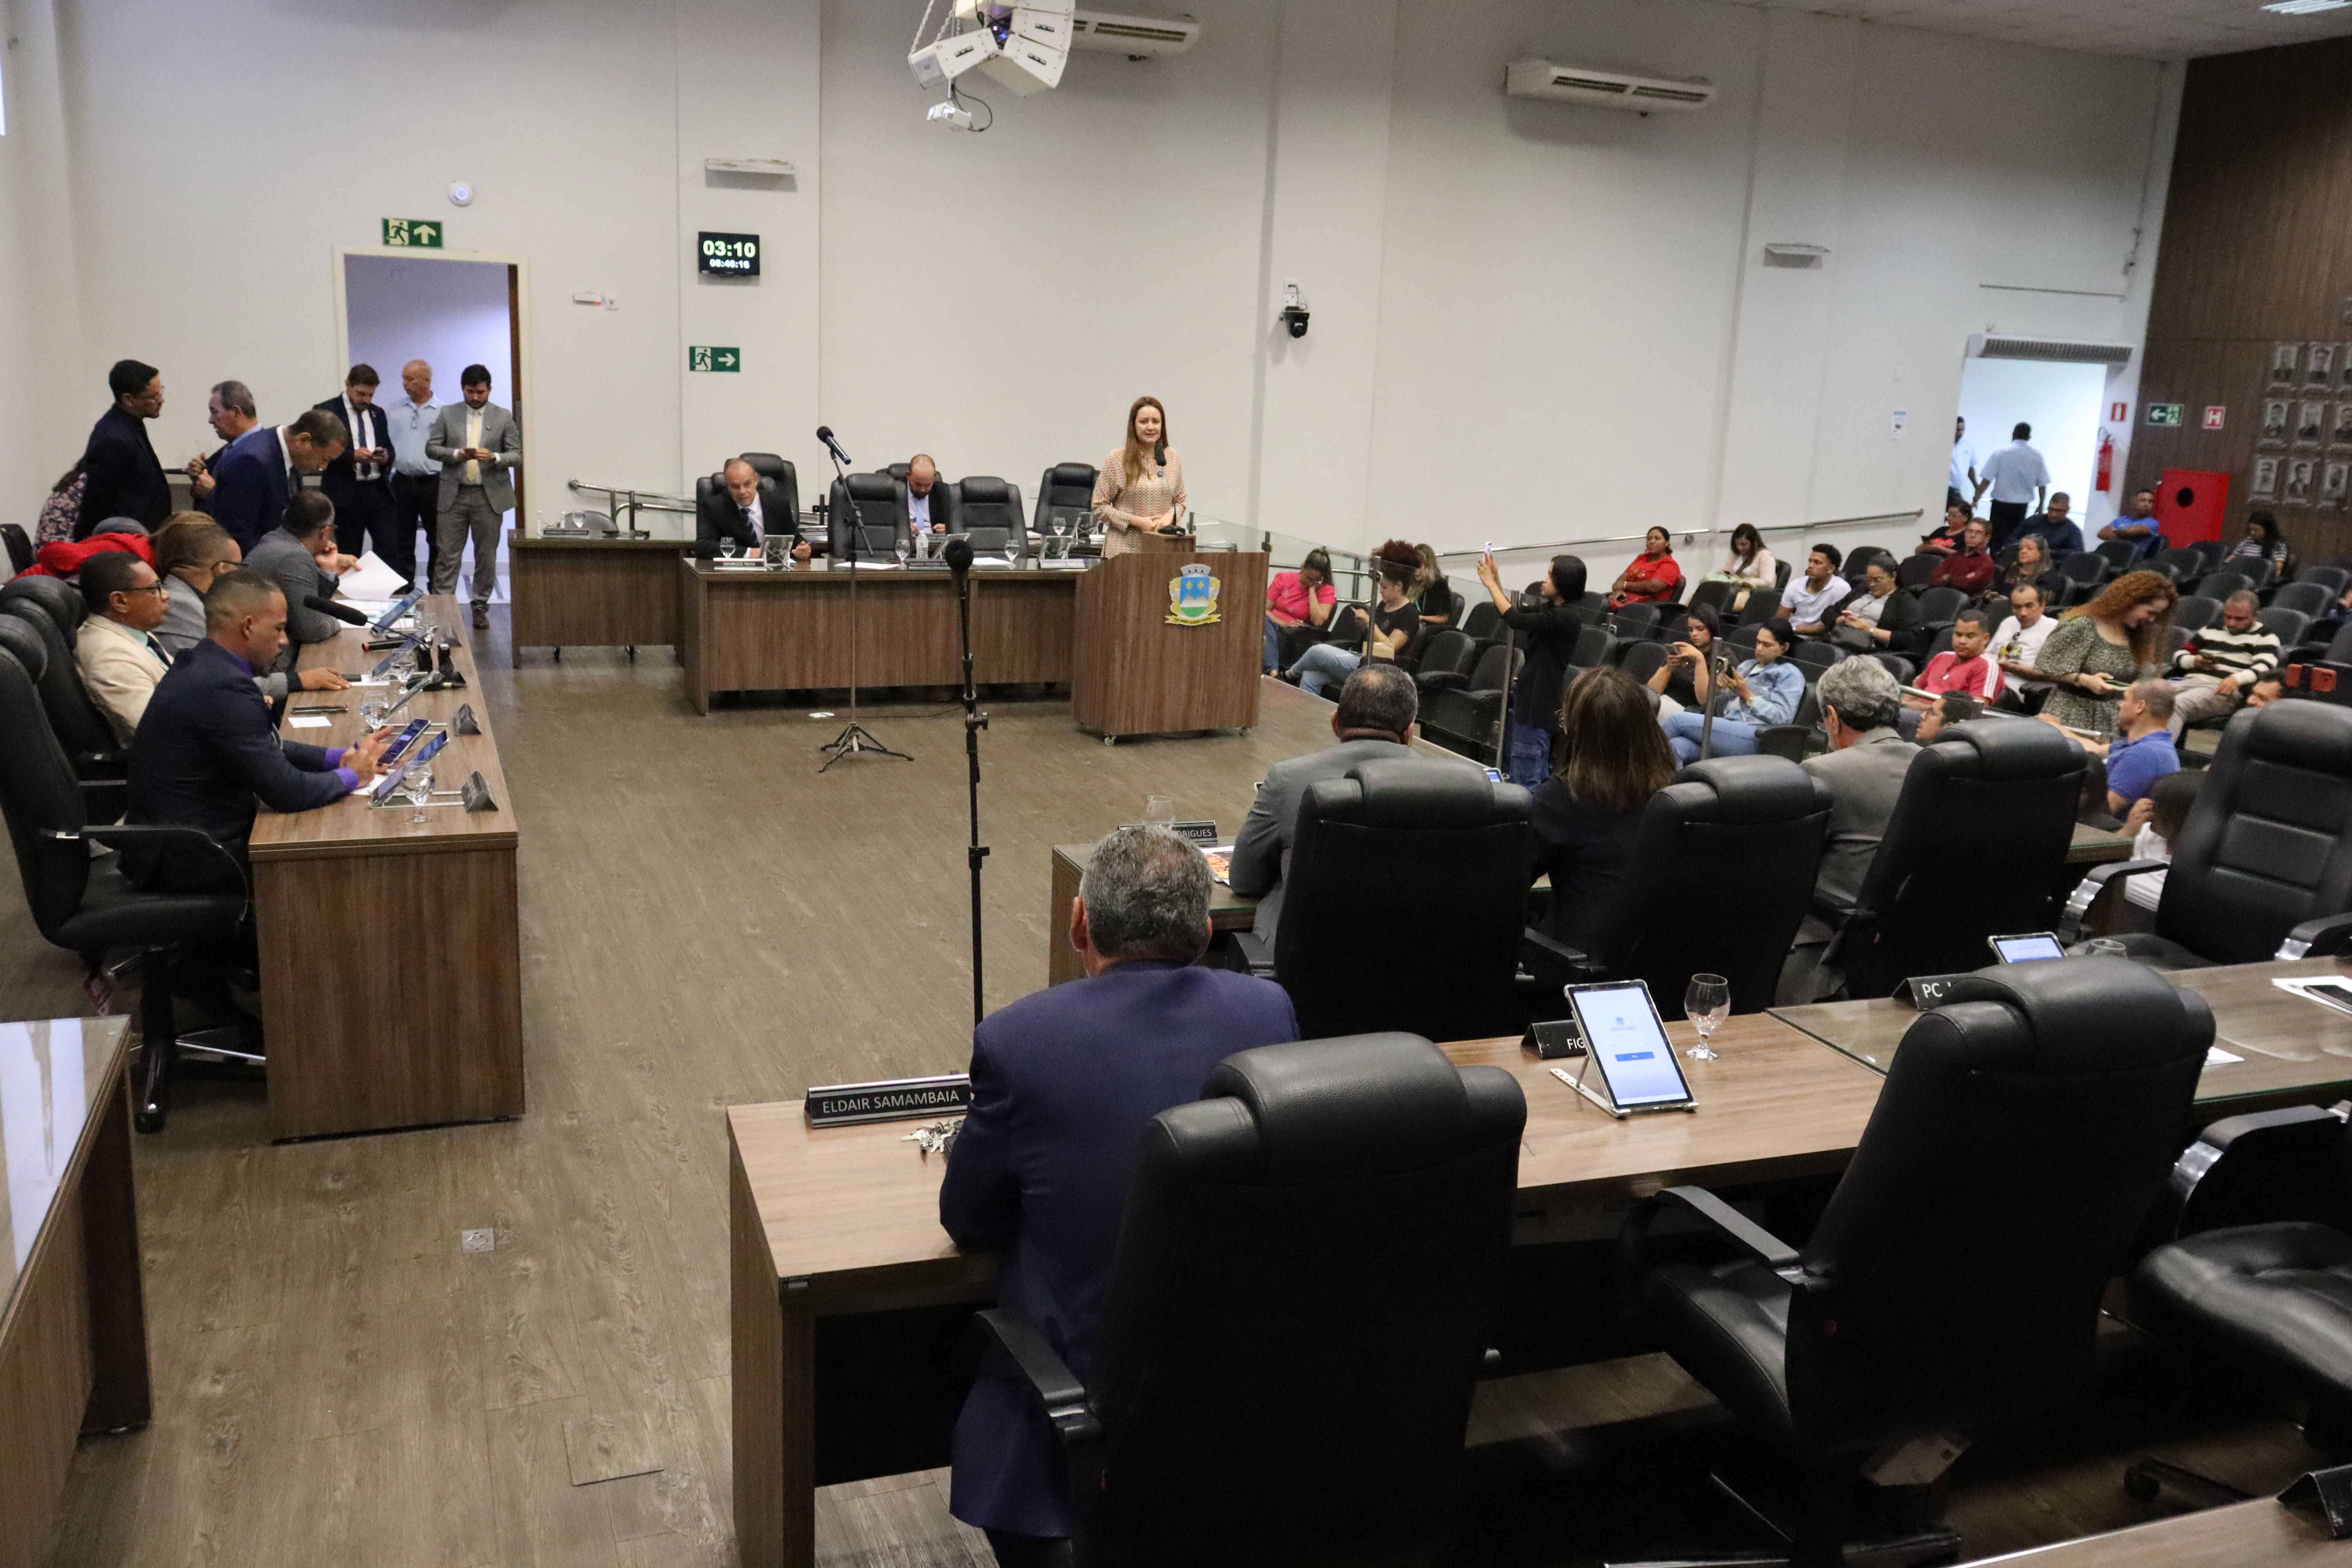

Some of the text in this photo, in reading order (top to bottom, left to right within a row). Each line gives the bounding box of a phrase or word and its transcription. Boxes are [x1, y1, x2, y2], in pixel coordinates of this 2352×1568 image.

[703, 240, 755, 258] 03:10
[2208, 410, 2221, 424] H
[1177, 829, 1212, 837] DRIGUES
[1567, 1037, 1585, 1049] FIG
[823, 1090, 959, 1114] ELDAIR SAMAMBAIA
